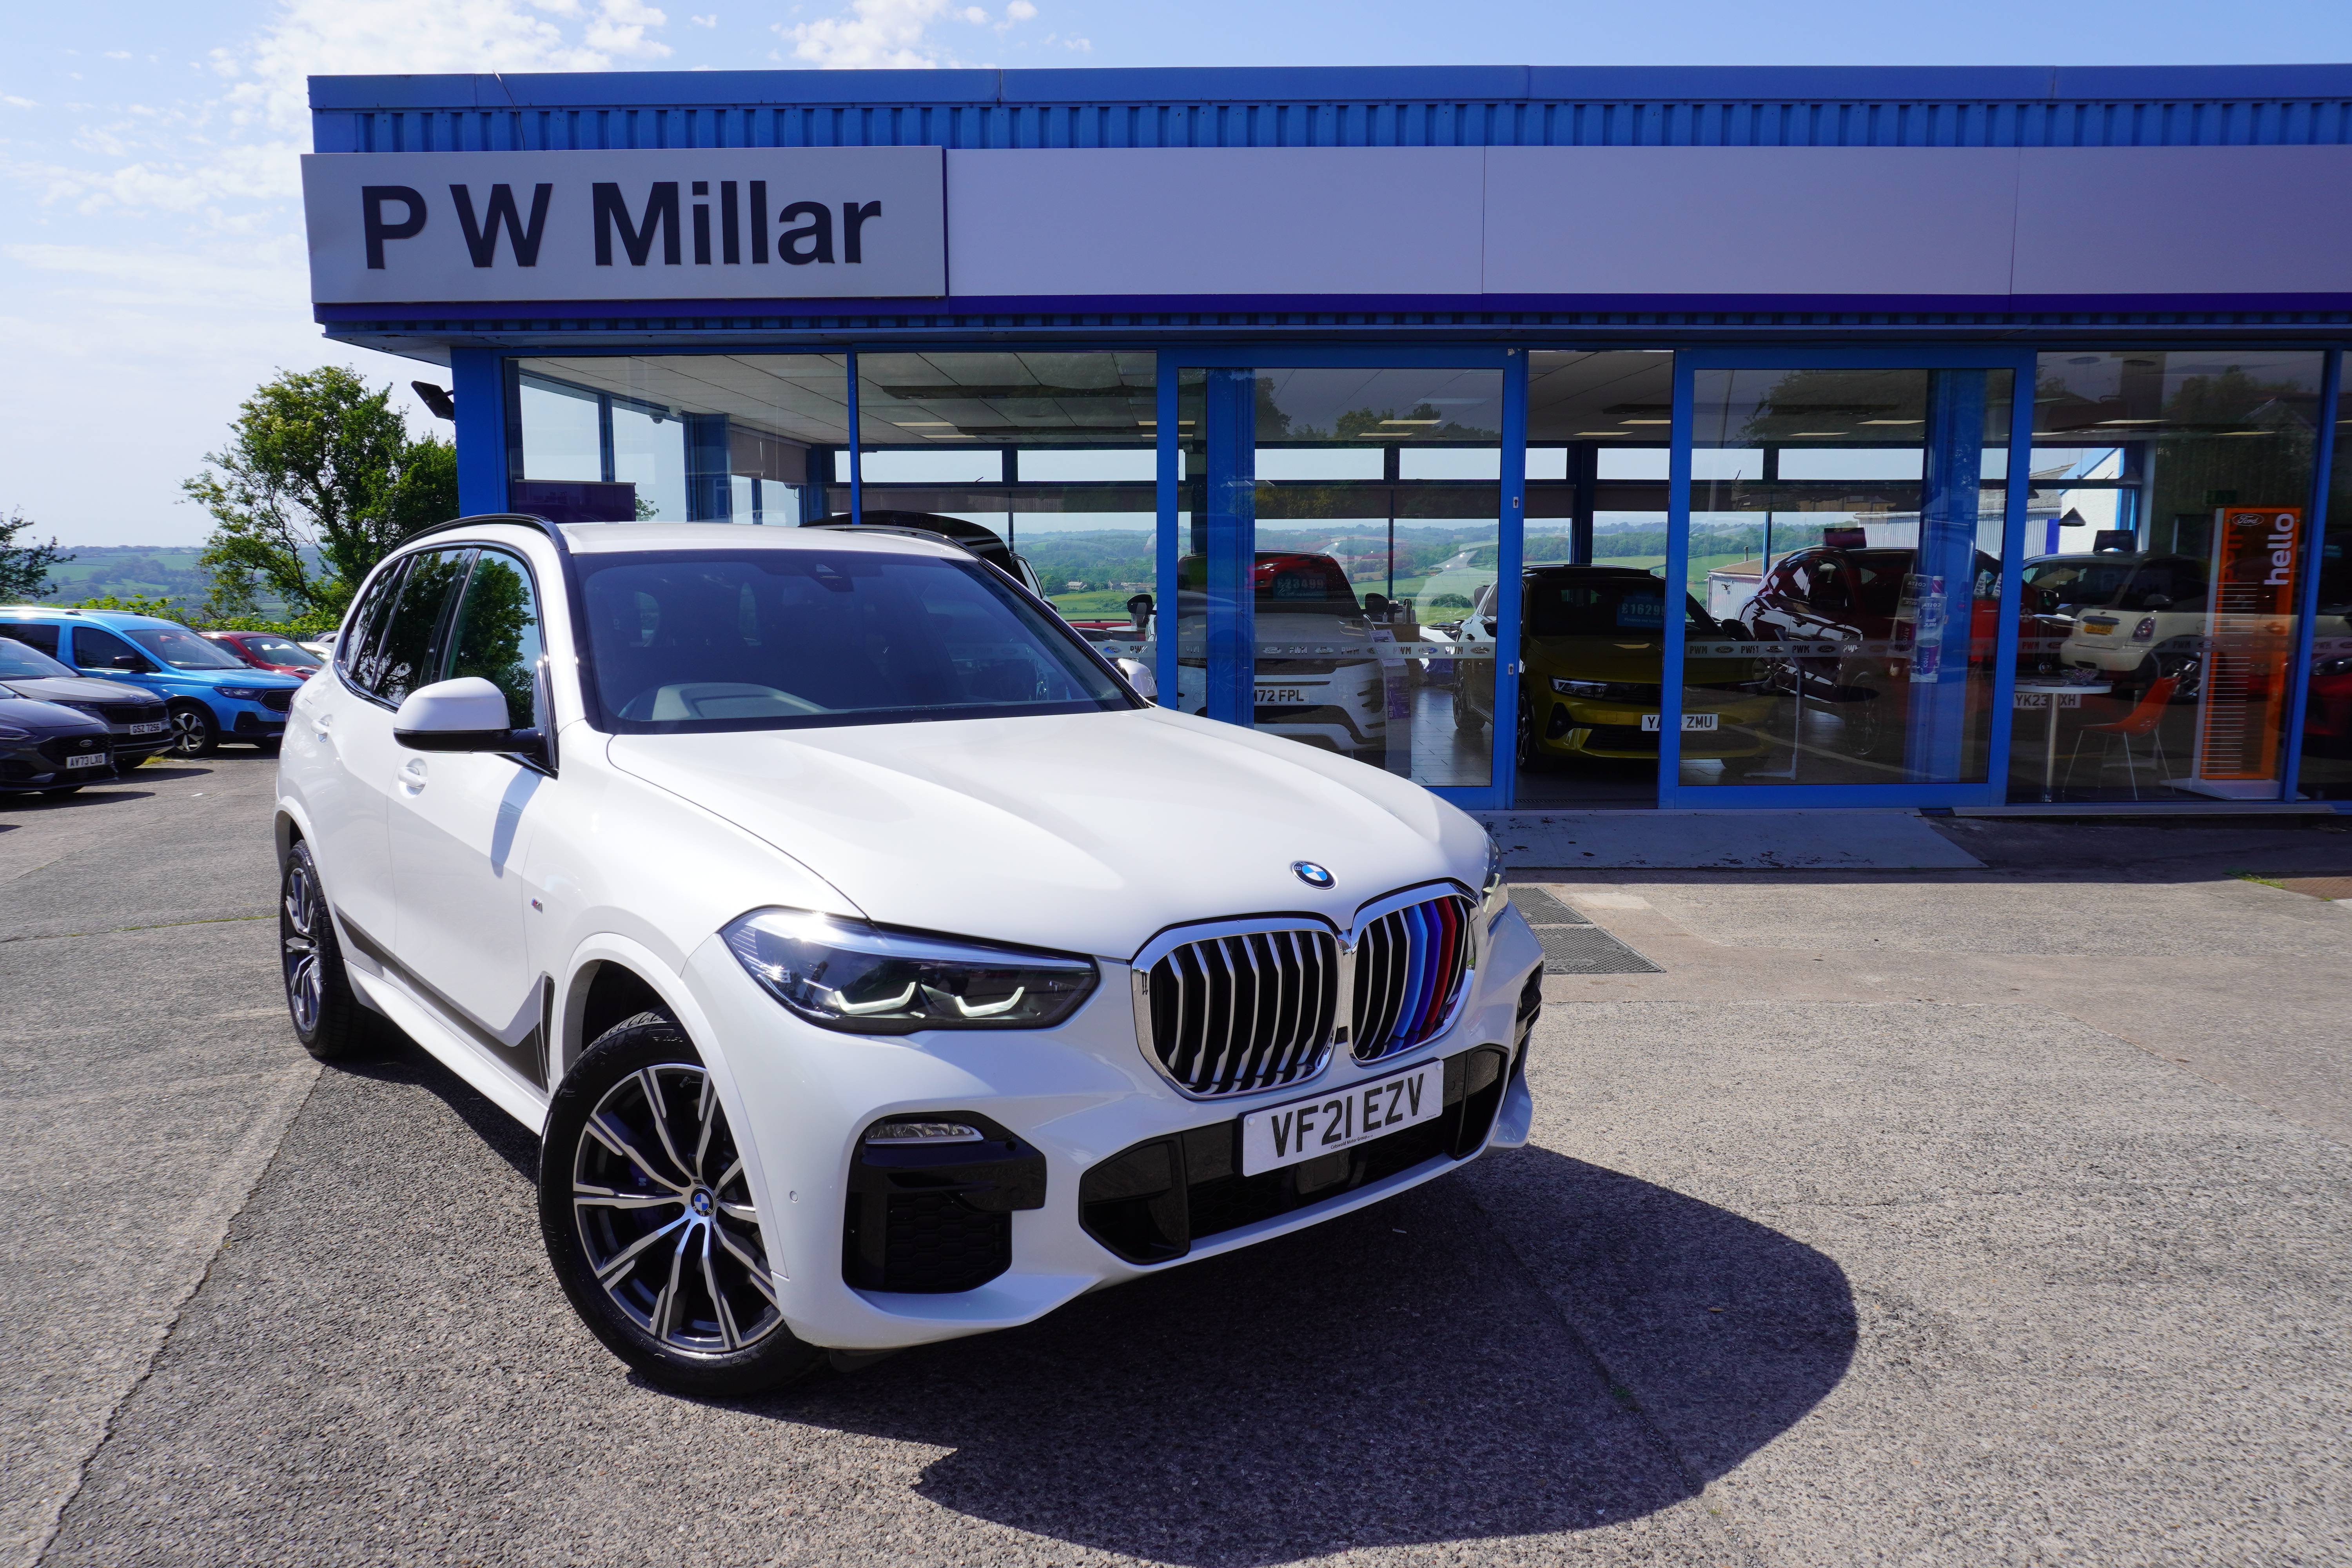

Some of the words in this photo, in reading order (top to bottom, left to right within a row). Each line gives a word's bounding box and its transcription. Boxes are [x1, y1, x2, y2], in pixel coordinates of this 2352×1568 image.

[362, 185, 427, 270] P
[449, 183, 553, 268] W
[592, 180, 881, 266] Millar
[2264, 513, 2295, 585] hello
[1445, 646, 1463, 654] PWM
[2022, 641, 2040, 650] PWM
[1279, 690, 1304, 702] FPL
[2016, 694, 2047, 706] YK23
[133, 725, 145, 733] GSZ
[146, 723, 160, 732] 7256
[1686, 716, 1712, 728] ZMU
[1271, 1095, 1352, 1158] VF21
[1363, 1073, 1424, 1134] EZV
[1330, 1141, 1346, 1149] Cotswold
